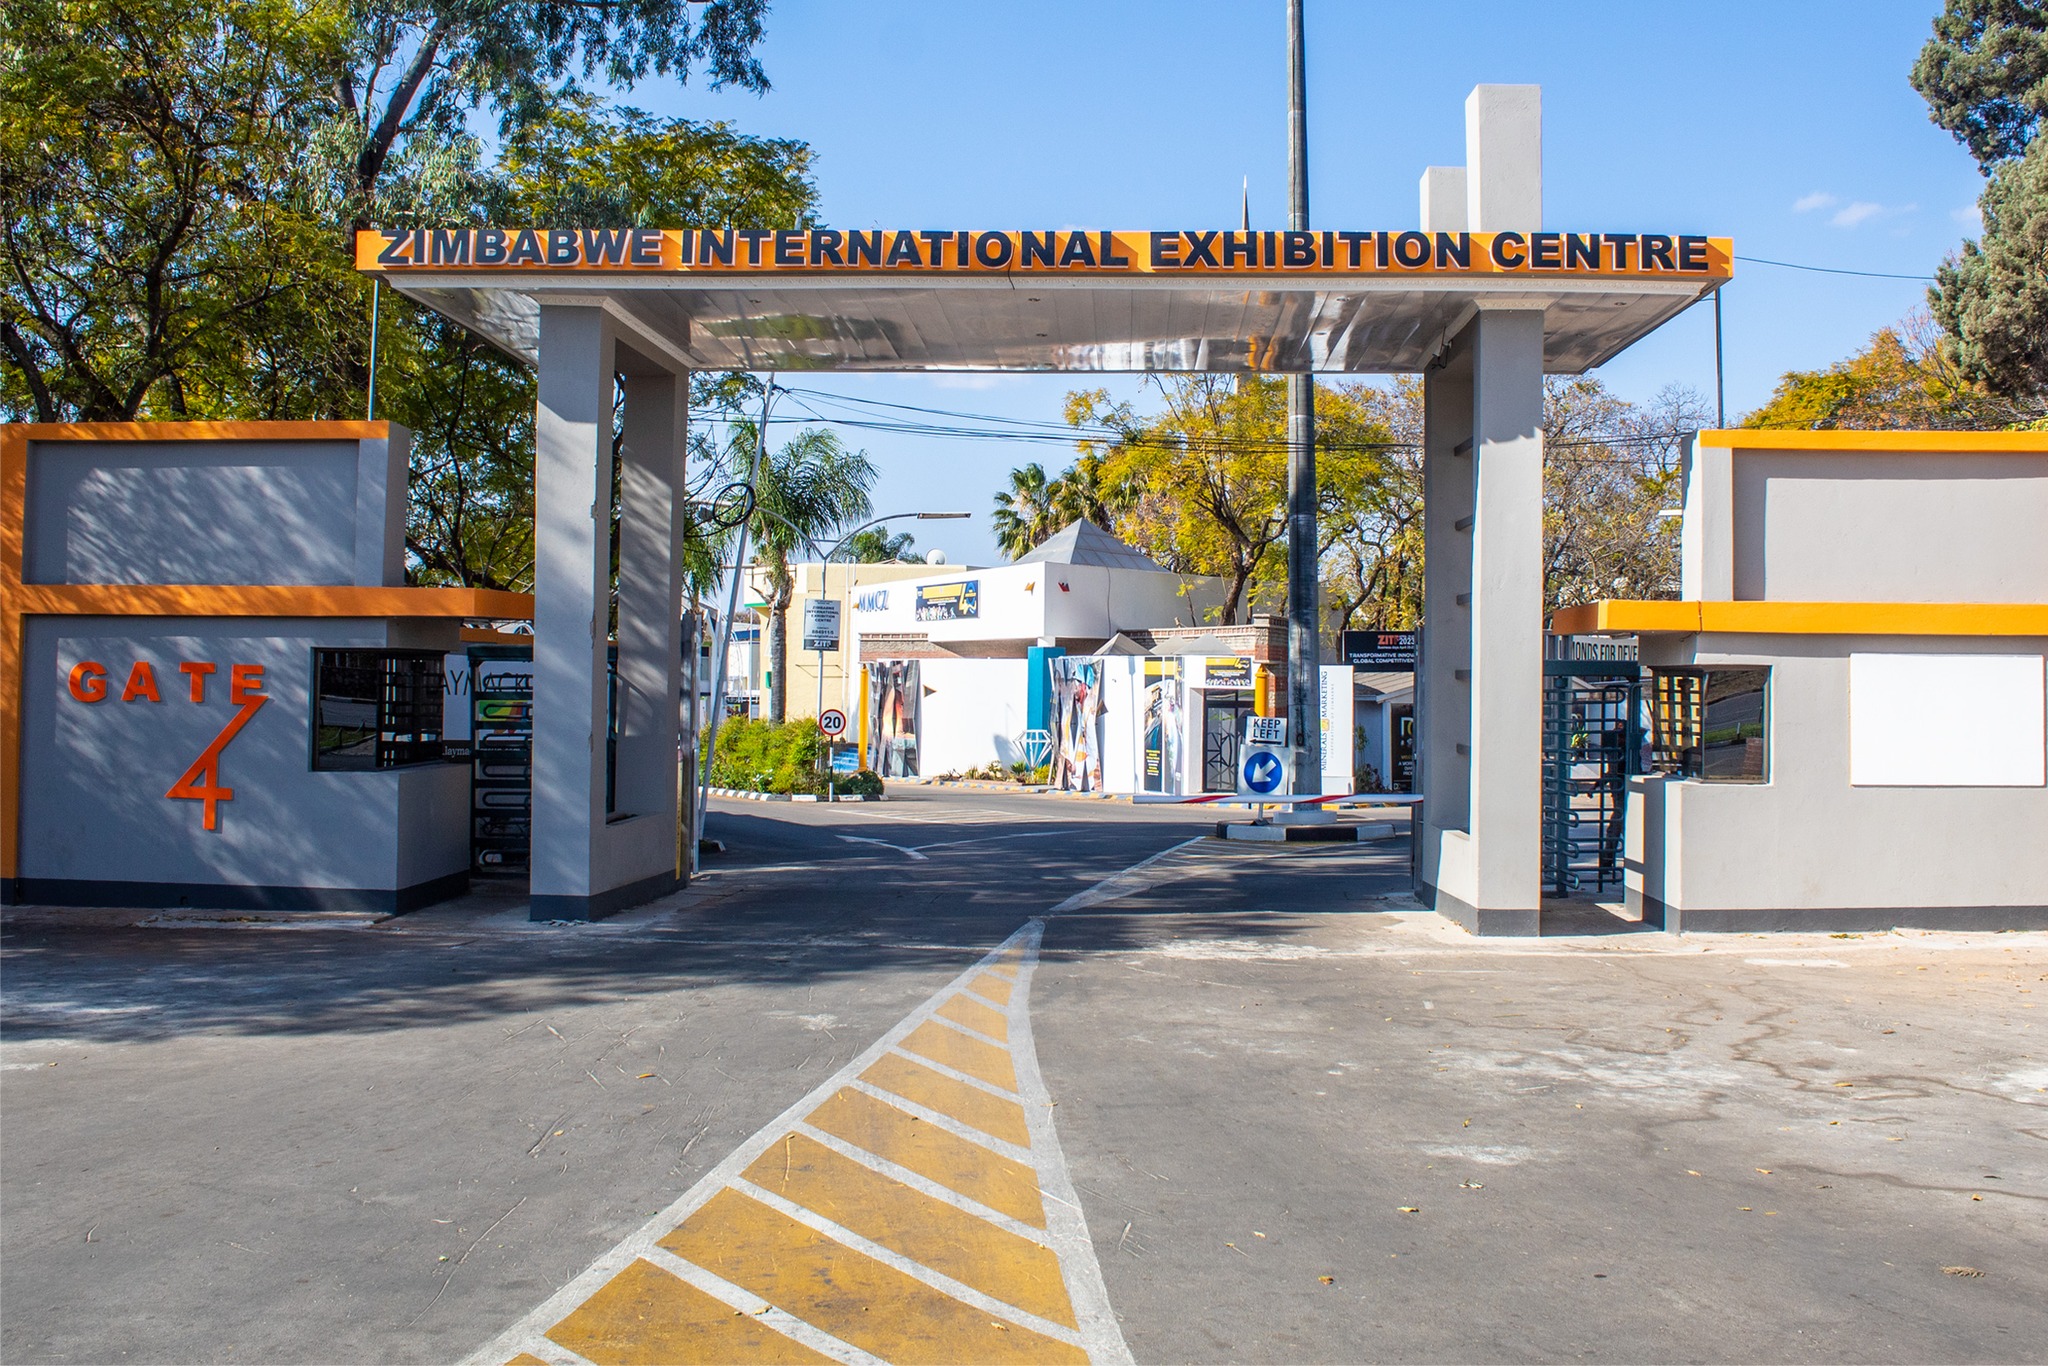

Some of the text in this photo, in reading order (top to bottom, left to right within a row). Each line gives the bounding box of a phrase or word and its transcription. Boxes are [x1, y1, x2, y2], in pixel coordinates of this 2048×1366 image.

[377, 229, 1709, 272] ZIMBABWE INTERNATIONAL EXHIBITION CENTRE
[858, 590, 889, 612] MMCZ
[68, 661, 268, 705] GATE
[824, 716, 841, 728] 20
[1253, 718, 1281, 728] KEEP
[1253, 729, 1279, 739] LEFT
[164, 694, 233, 830] 4
